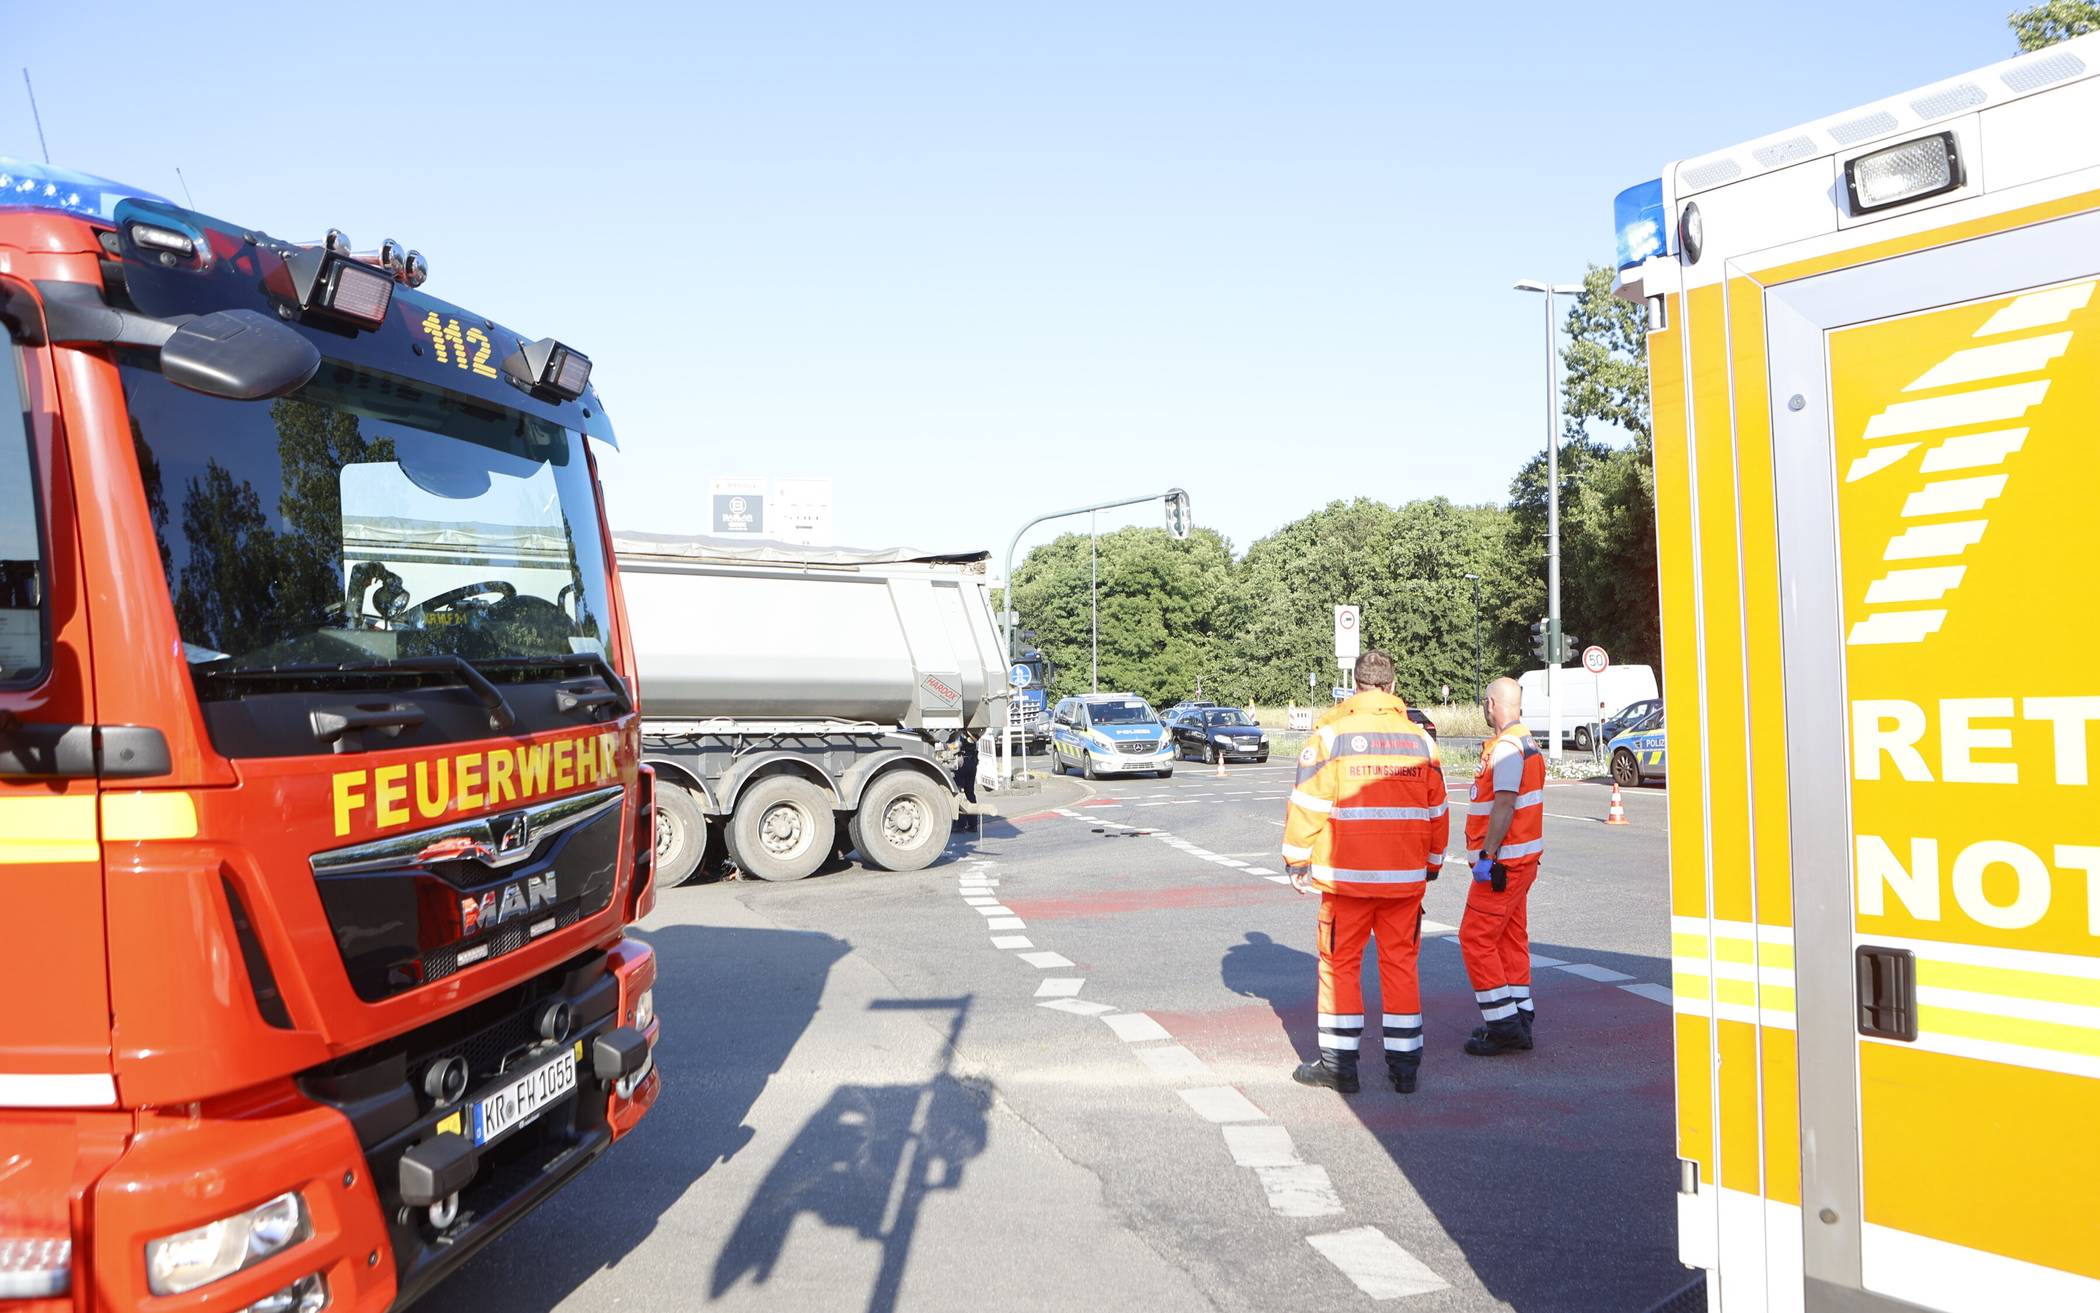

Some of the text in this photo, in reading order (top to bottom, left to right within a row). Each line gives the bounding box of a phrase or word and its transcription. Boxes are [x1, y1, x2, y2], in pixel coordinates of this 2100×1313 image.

[422, 311, 497, 379] 112
[927, 678, 958, 701] HARDOX
[1588, 653, 1604, 667] 50
[1349, 765, 1423, 778] RETTUNGSDIENST
[1851, 695, 2100, 786] RET
[332, 732, 619, 838] FEUERWEHR
[461, 870, 558, 936] MAN
[485, 1055, 574, 1134] KR FW 1055
